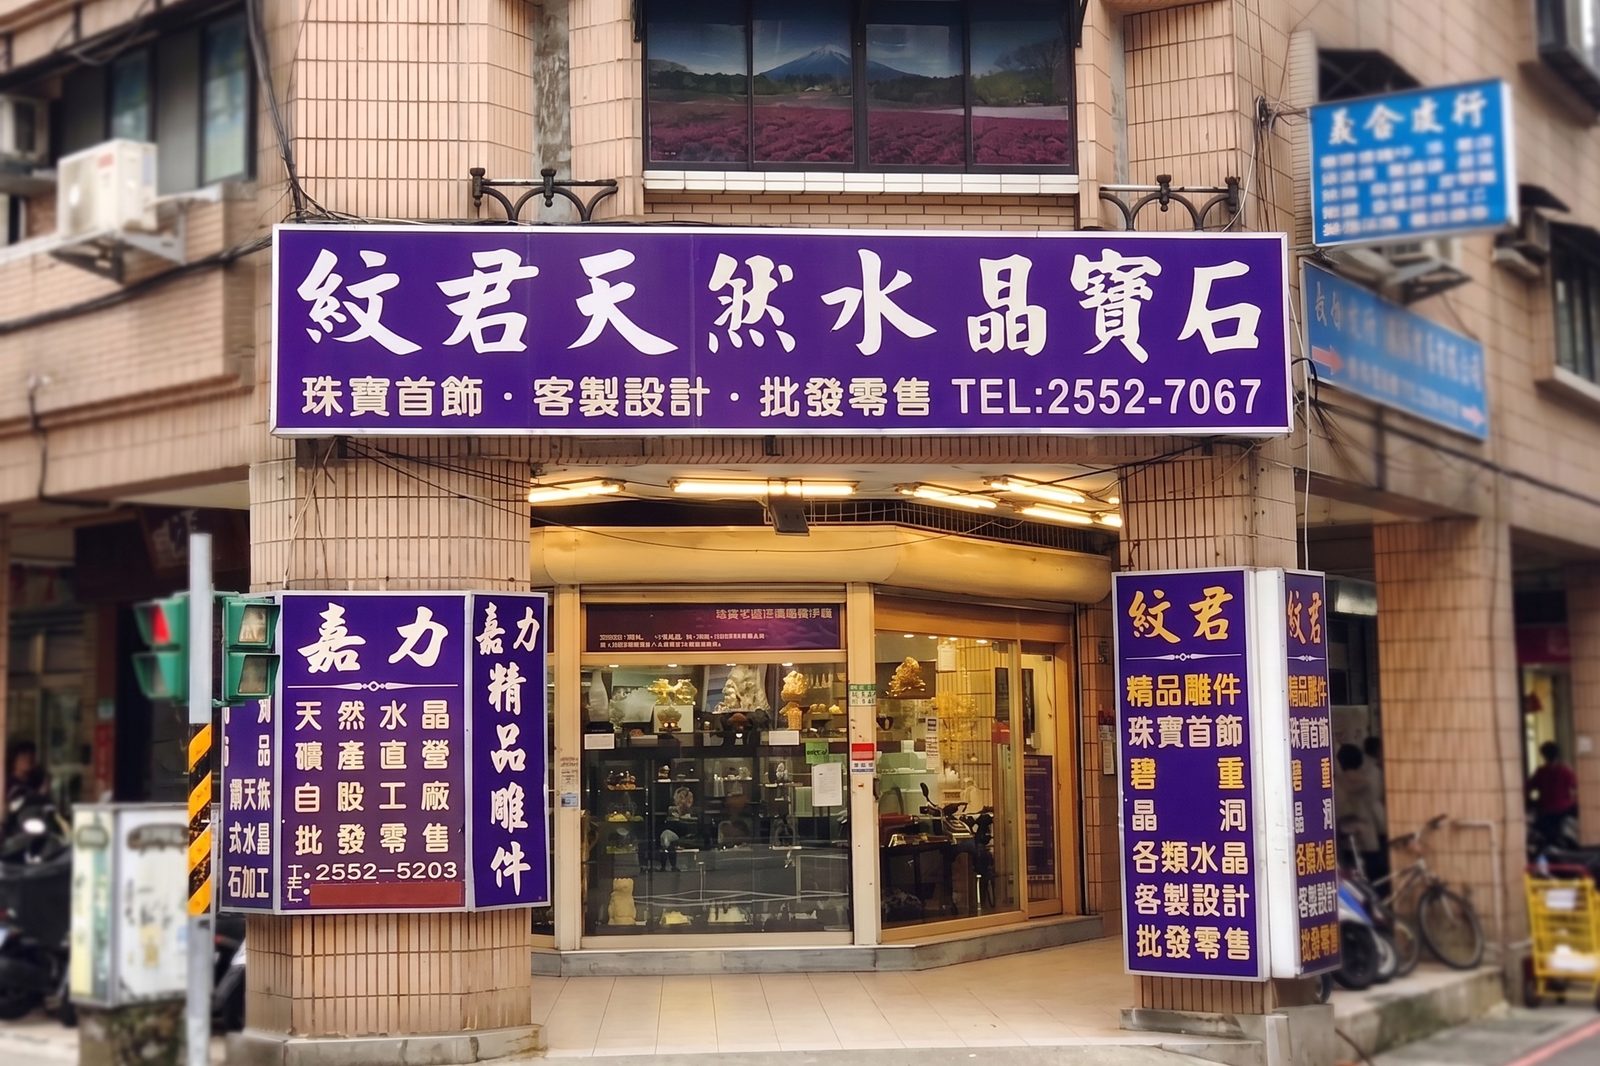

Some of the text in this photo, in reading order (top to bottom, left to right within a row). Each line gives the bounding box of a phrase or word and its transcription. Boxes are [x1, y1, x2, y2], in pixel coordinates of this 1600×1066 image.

[296, 248, 1262, 364] 紋君天然水晶寶石
[951, 378, 1261, 415] TEL:2552-7067
[475, 601, 541, 655] 嘉力
[1128, 586, 1234, 644] 紋君
[297, 602, 449, 674] 嘉力
[1126, 672, 1242, 708] 精品雕件
[294, 699, 450, 731] 天然水晶
[1127, 714, 1243, 749] 珠寶首飾
[294, 739, 450, 771] 礦產直營
[294, 780, 450, 813] 自股工廠
[487, 661, 531, 896] 精品雕件
[1132, 799, 1247, 832] 晶洞
[294, 822, 449, 856] 批發零售
[1132, 840, 1249, 875] 各類水晶
[1134, 882, 1250, 918] 客製設計
[1136, 923, 1251, 960] 批發零售
